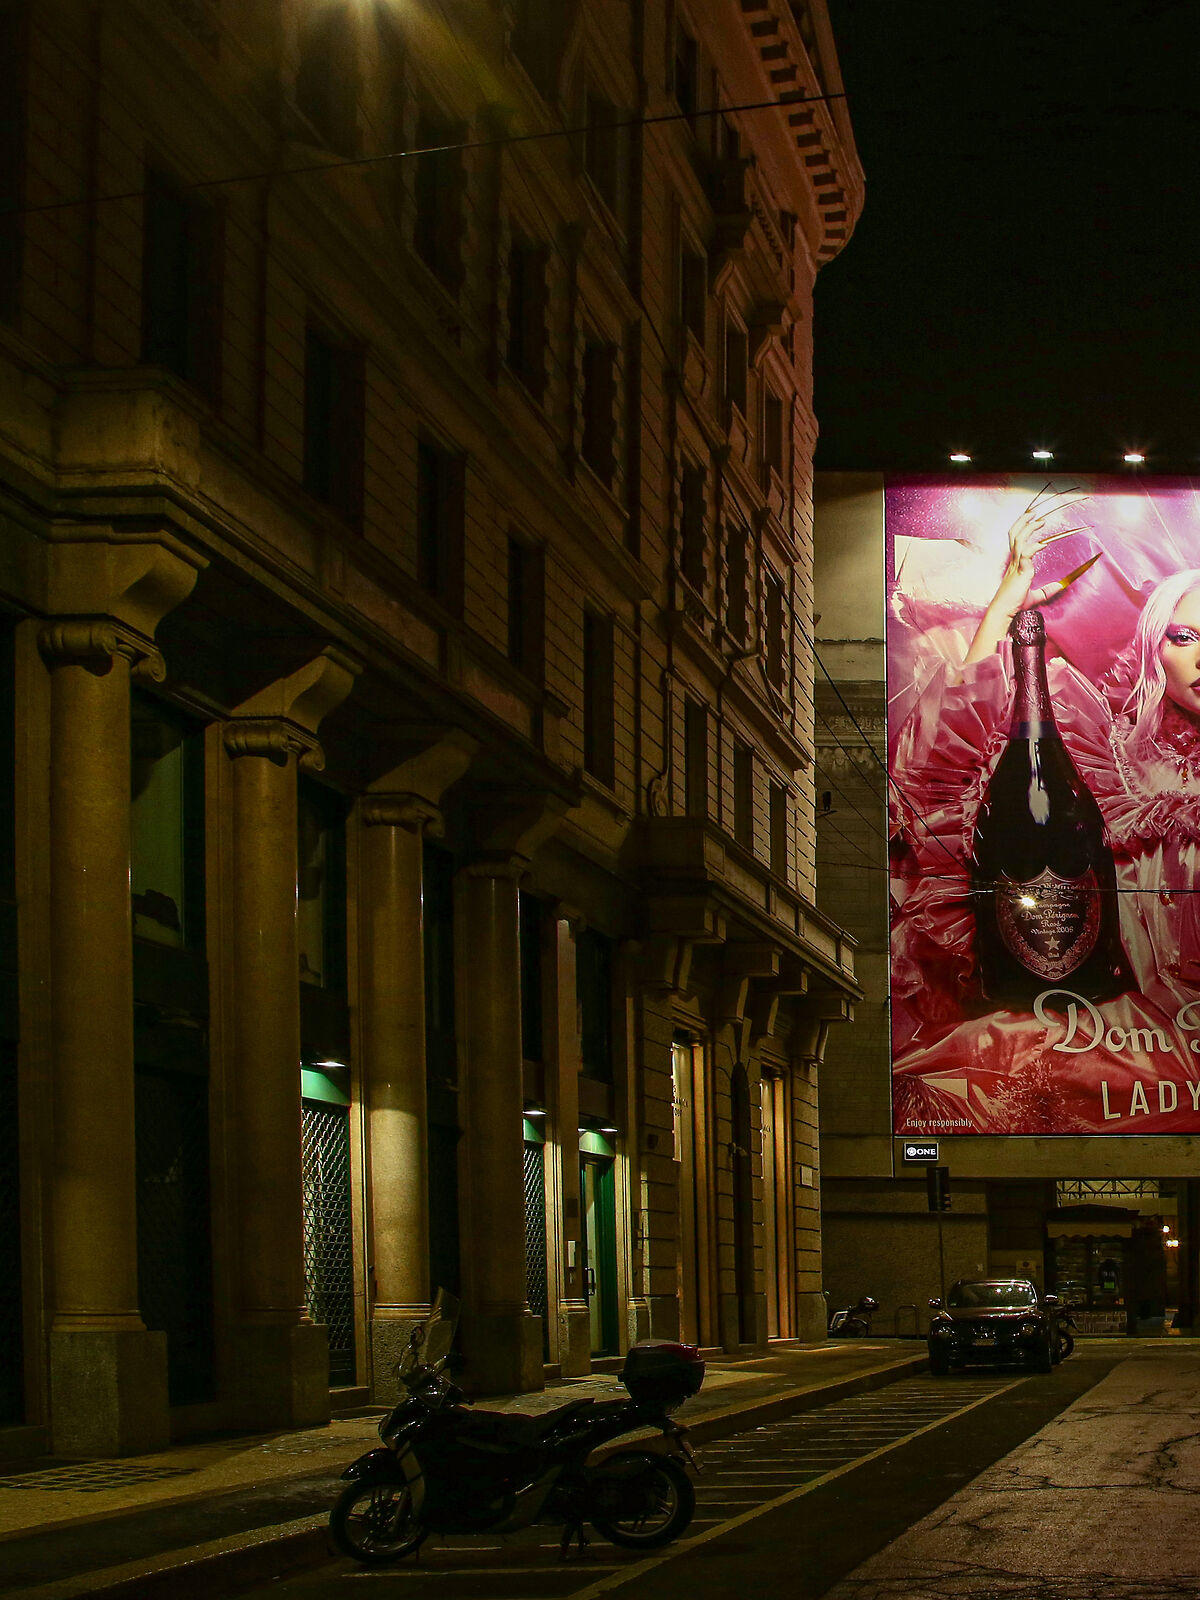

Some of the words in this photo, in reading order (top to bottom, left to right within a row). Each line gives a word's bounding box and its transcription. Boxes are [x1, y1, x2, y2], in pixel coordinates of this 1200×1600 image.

[1021, 910, 1043, 921] Dom
[1033, 989, 1173, 1053] Dom
[906, 1118, 926, 1128] Enjoy
